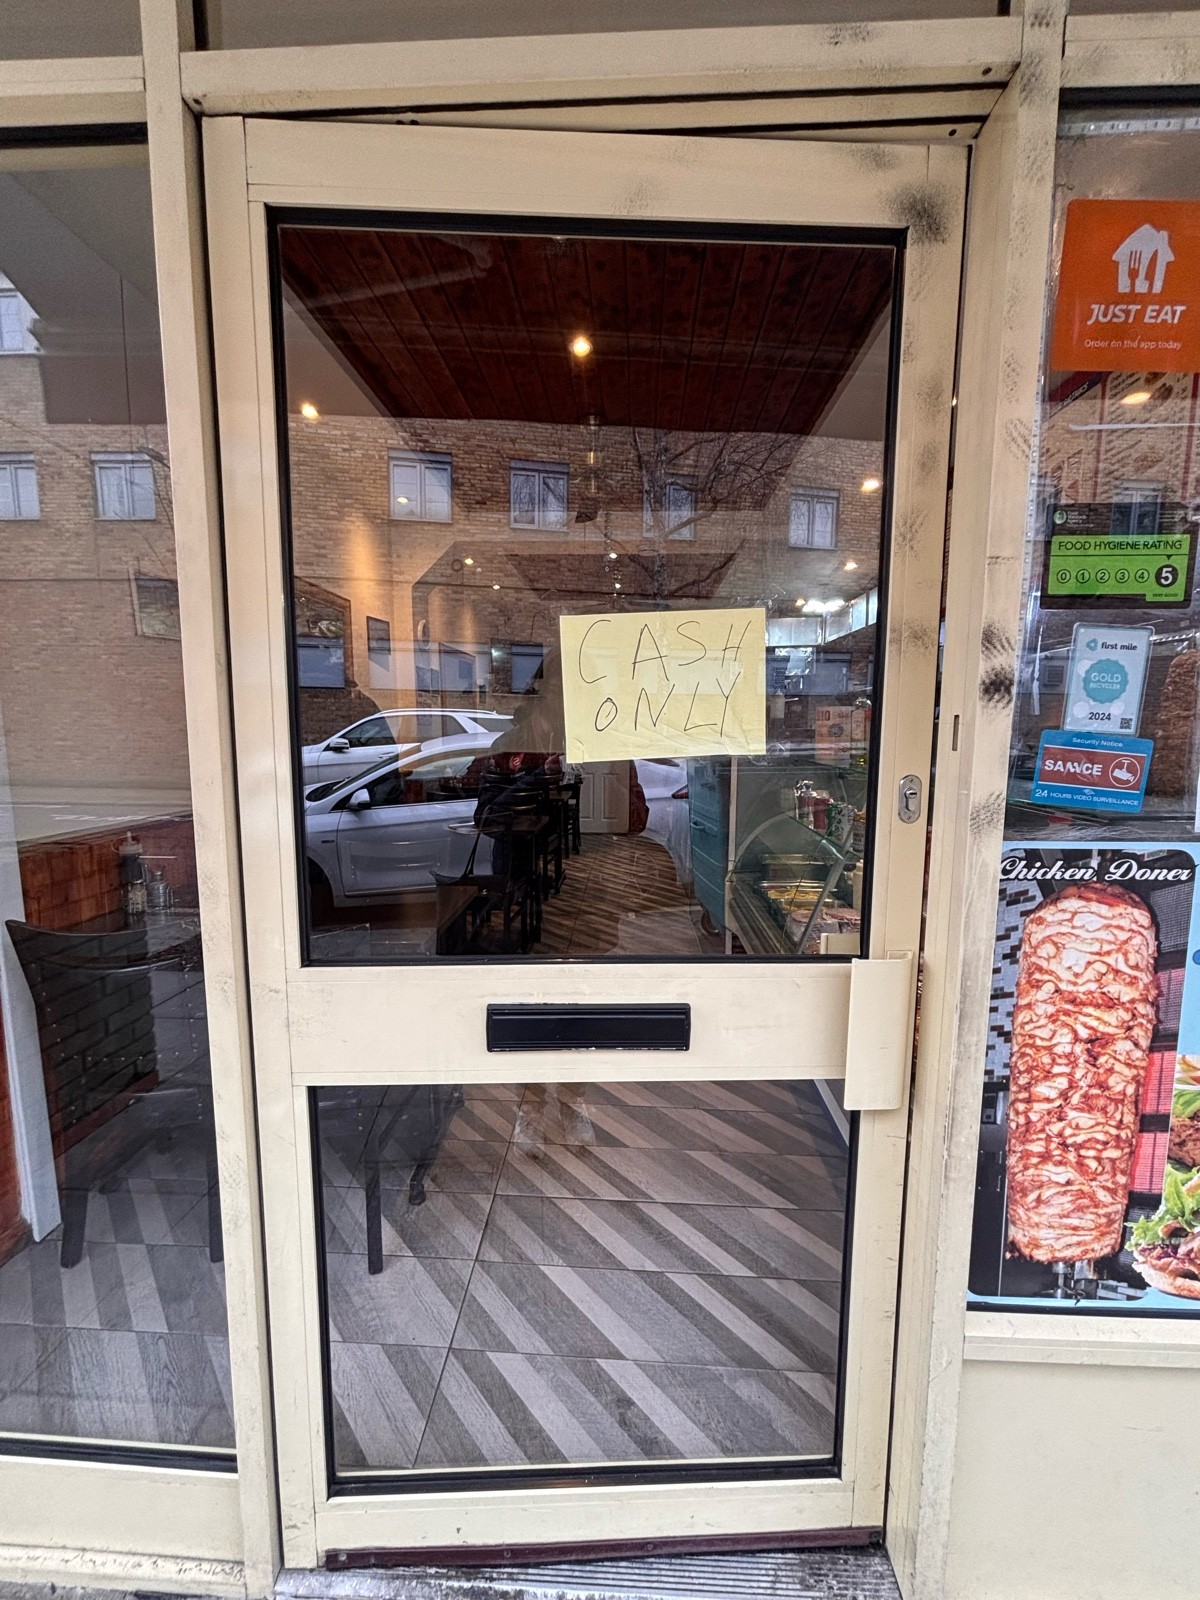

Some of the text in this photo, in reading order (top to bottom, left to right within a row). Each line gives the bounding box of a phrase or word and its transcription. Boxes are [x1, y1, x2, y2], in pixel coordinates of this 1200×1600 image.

[1087, 304, 1187, 325] JUST EAT
[1085, 339, 1108, 348] Order
[1124, 339, 1138, 348] the
[1140, 341, 1156, 350] app
[1158, 340, 1183, 350] today
[1058, 539, 1182, 551] FOOD HYGIENE RATING
[1160, 567, 1173, 585] 5
[578, 619, 752, 684] CASH
[1101, 641, 1137, 651] first mile
[1091, 672, 1121, 683] GOLD
[594, 671, 741, 738] ONLY
[1088, 711, 1112, 721] 2024
[1072, 737, 1123, 747] Security Notice
[1035, 789, 1049, 798] 24
[1073, 793, 1092, 801] VIDEO
[1093, 796, 1139, 806] SURVEILLANCE
[1000, 857, 1193, 881] Chicken Doner
